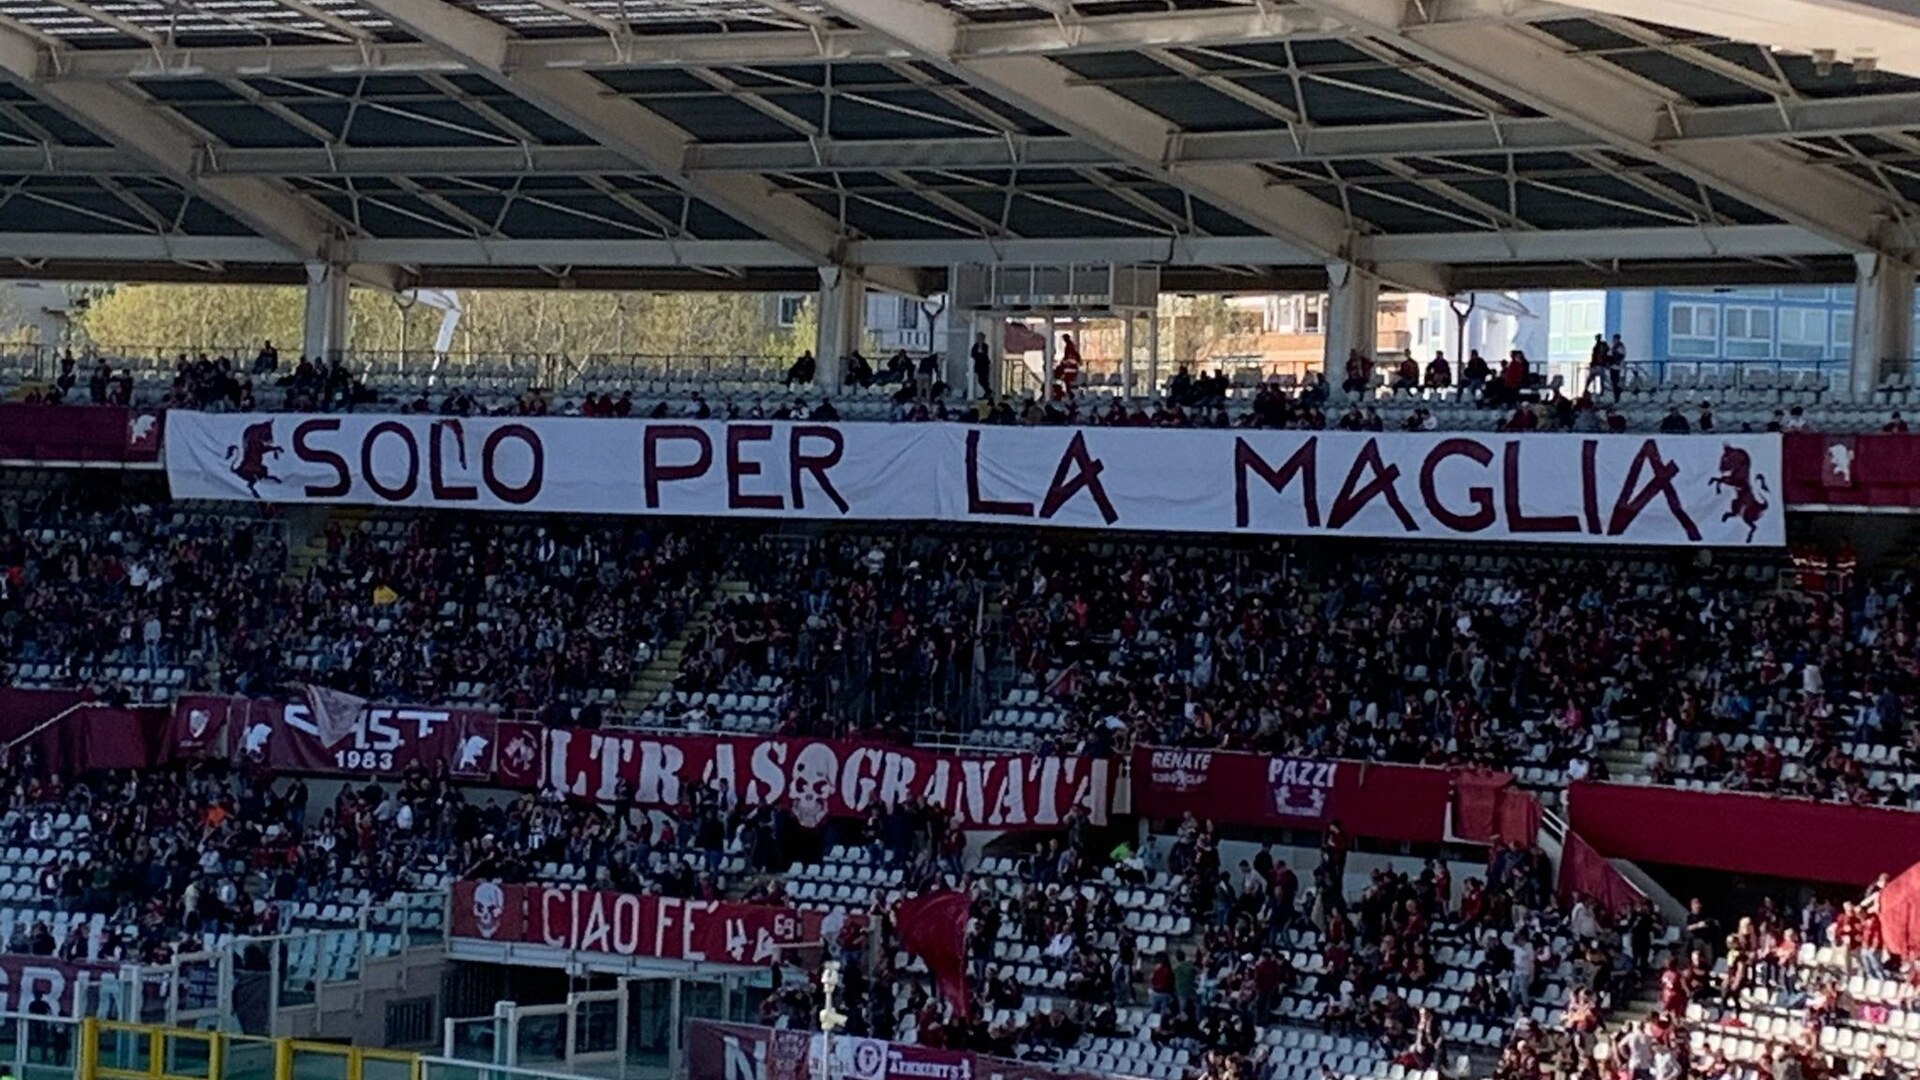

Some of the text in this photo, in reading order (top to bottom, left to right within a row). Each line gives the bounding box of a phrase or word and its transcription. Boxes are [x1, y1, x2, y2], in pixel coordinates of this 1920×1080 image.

[292, 418, 1702, 541] SOLO PER LA MAGLIA
[334, 750, 393, 770] 1983
[1151, 751, 1212, 771] RENATE
[1268, 757, 1338, 787] PAZZI
[841, 747, 1108, 827] GRANATA
[542, 888, 640, 955] CIAO
